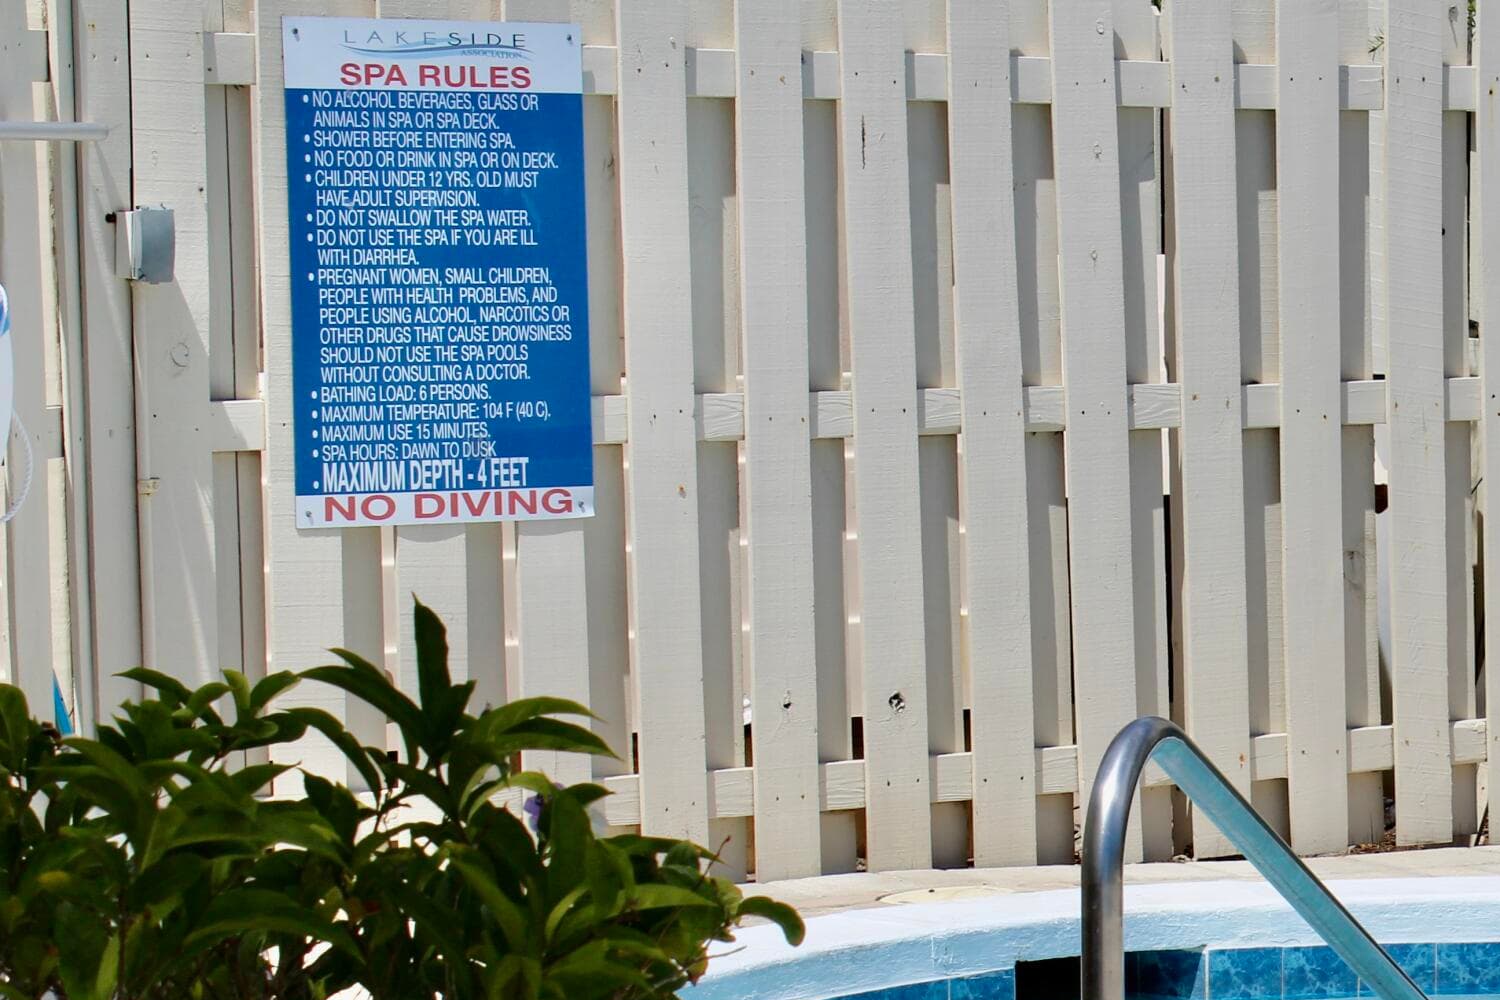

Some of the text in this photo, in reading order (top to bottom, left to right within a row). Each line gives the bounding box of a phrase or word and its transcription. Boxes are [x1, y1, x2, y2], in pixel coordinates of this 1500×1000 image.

[344, 30, 526, 48] LAKESIDE
[460, 49, 522, 59] ASSOCIATION
[340, 63, 531, 88] SPA RULES
[312, 91, 538, 112] NO ALCOHOL BEVERAGES, GLASS OR
[314, 111, 499, 129] ANIMALS IN SPA OR SPA DECK.
[314, 132, 515, 149] SHOWER BEFORE ENTERING SPA.
[315, 151, 558, 168] NO FOOD OR DRINK IN SPA OR ON DECK.
[315, 171, 539, 187] CHILDREN UNDER 12 YRS. OLD MUST
[316, 191, 479, 206] HAVE ADULT SUPERVISION.
[316, 210, 530, 226] DO NOT SWALLOW THE SPA WATER.
[318, 229, 537, 246] DO NOT USE THE SPA IF YOU ARE ILL
[318, 249, 419, 265] WITH DIARRHEA.
[318, 267, 552, 286] PREGNANT WOMEN, SMALL CHILDREN,
[319, 287, 557, 306] PEOPLE WITH HEALTH PROBLEMS, AND
[320, 306, 569, 325] PEOPLE USING ALCOHOL, NARCOTICS OR
[320, 325, 571, 344] OTHER DRUGS THAT CAUSE DROWSINESS
[321, 345, 528, 363] SHOULD NOT USE THE SPA POOLS
[321, 364, 530, 383] WITHOUT CONSULTING A DOCTOR.
[322, 384, 490, 402] BATHING LOAD: 6 PERSONS.
[322, 400, 551, 422] MAXIMUM TEMPERATURE: 104 F (40 C).
[322, 423, 490, 441] MAXIMUM USE 15 MINUTES.
[323, 441, 496, 461] SPA HOURS: DAWN TO DUSK
[323, 460, 405, 492] MAXIMUM
[413, 459, 463, 490] DEPTH
[478, 459, 487, 488] 4
[490, 457, 528, 487] FEET
[325, 489, 573, 521] NO DIVING
